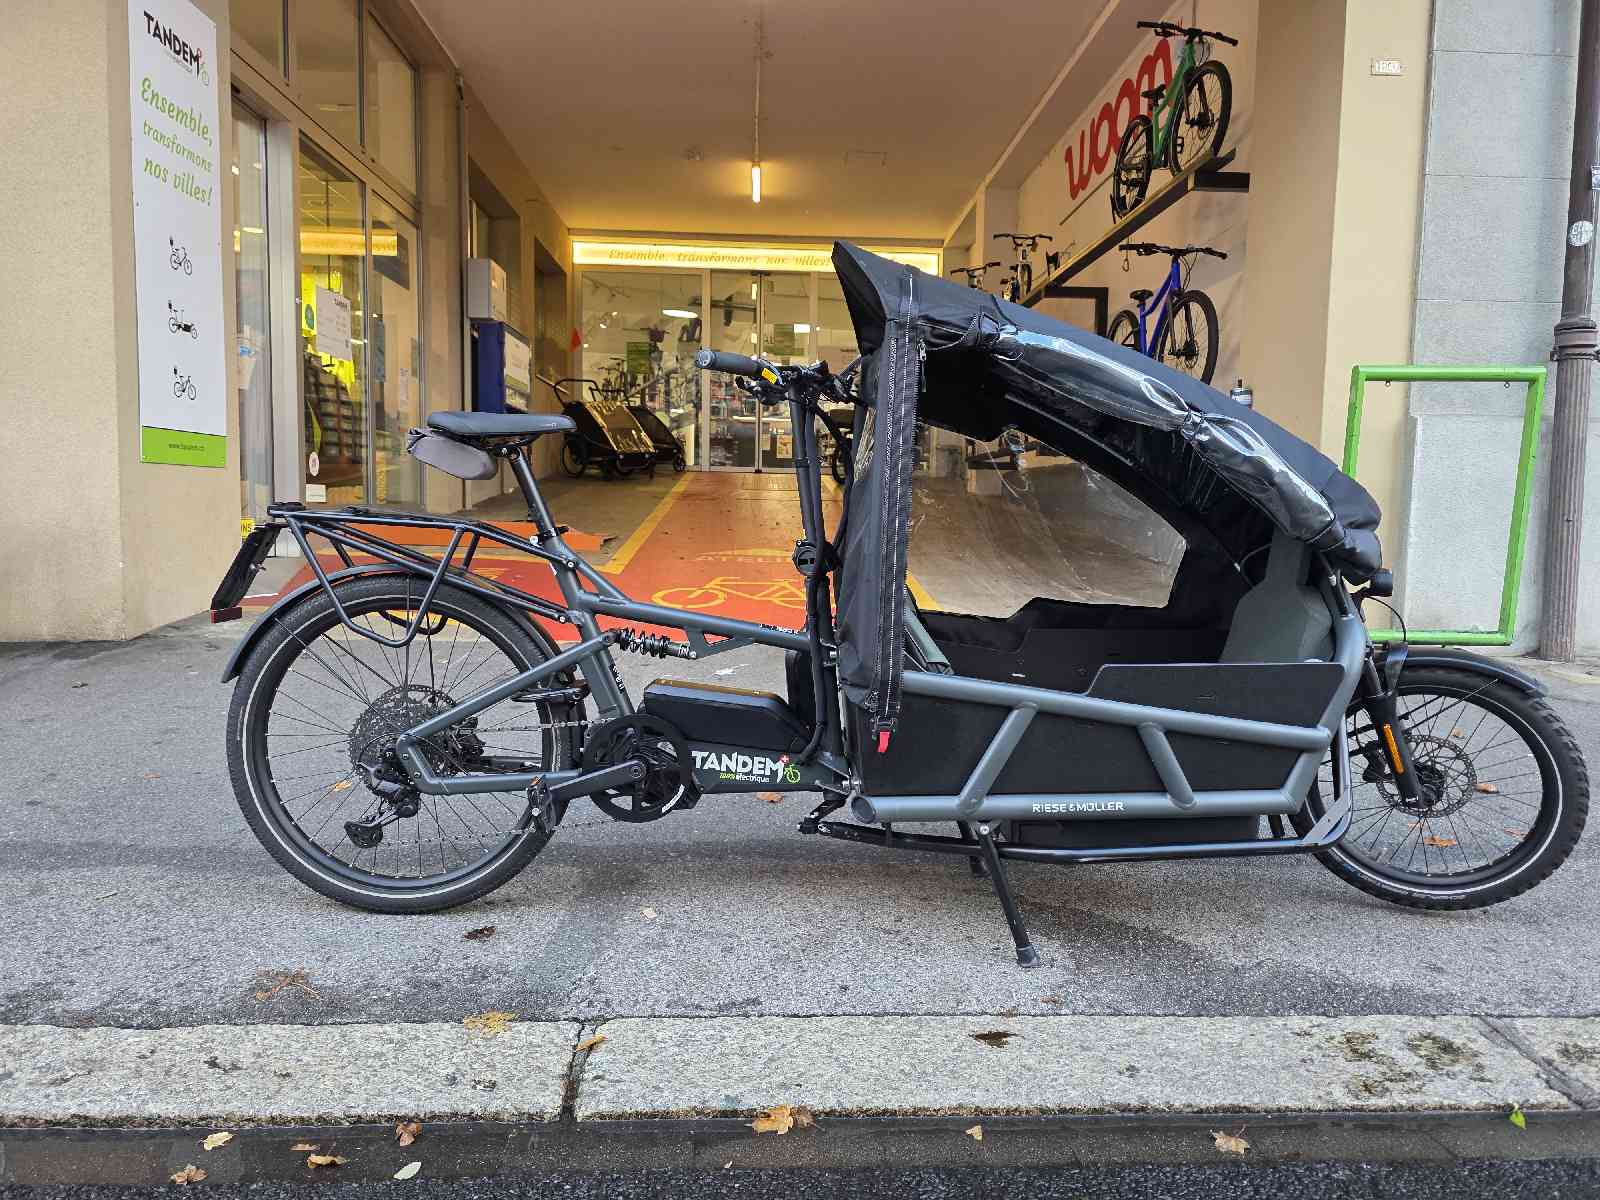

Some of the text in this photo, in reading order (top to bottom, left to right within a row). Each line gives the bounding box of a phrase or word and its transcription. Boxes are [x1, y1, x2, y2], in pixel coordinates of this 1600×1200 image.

[143, 10, 200, 80] TANDEM
[140, 76, 213, 147] Ensemble,
[1065, 38, 1173, 200] woom
[143, 119, 212, 173] transformons
[143, 156, 213, 207] nos villes!
[691, 750, 785, 783] TANDEM
[1032, 803, 1068, 814] RIESE
